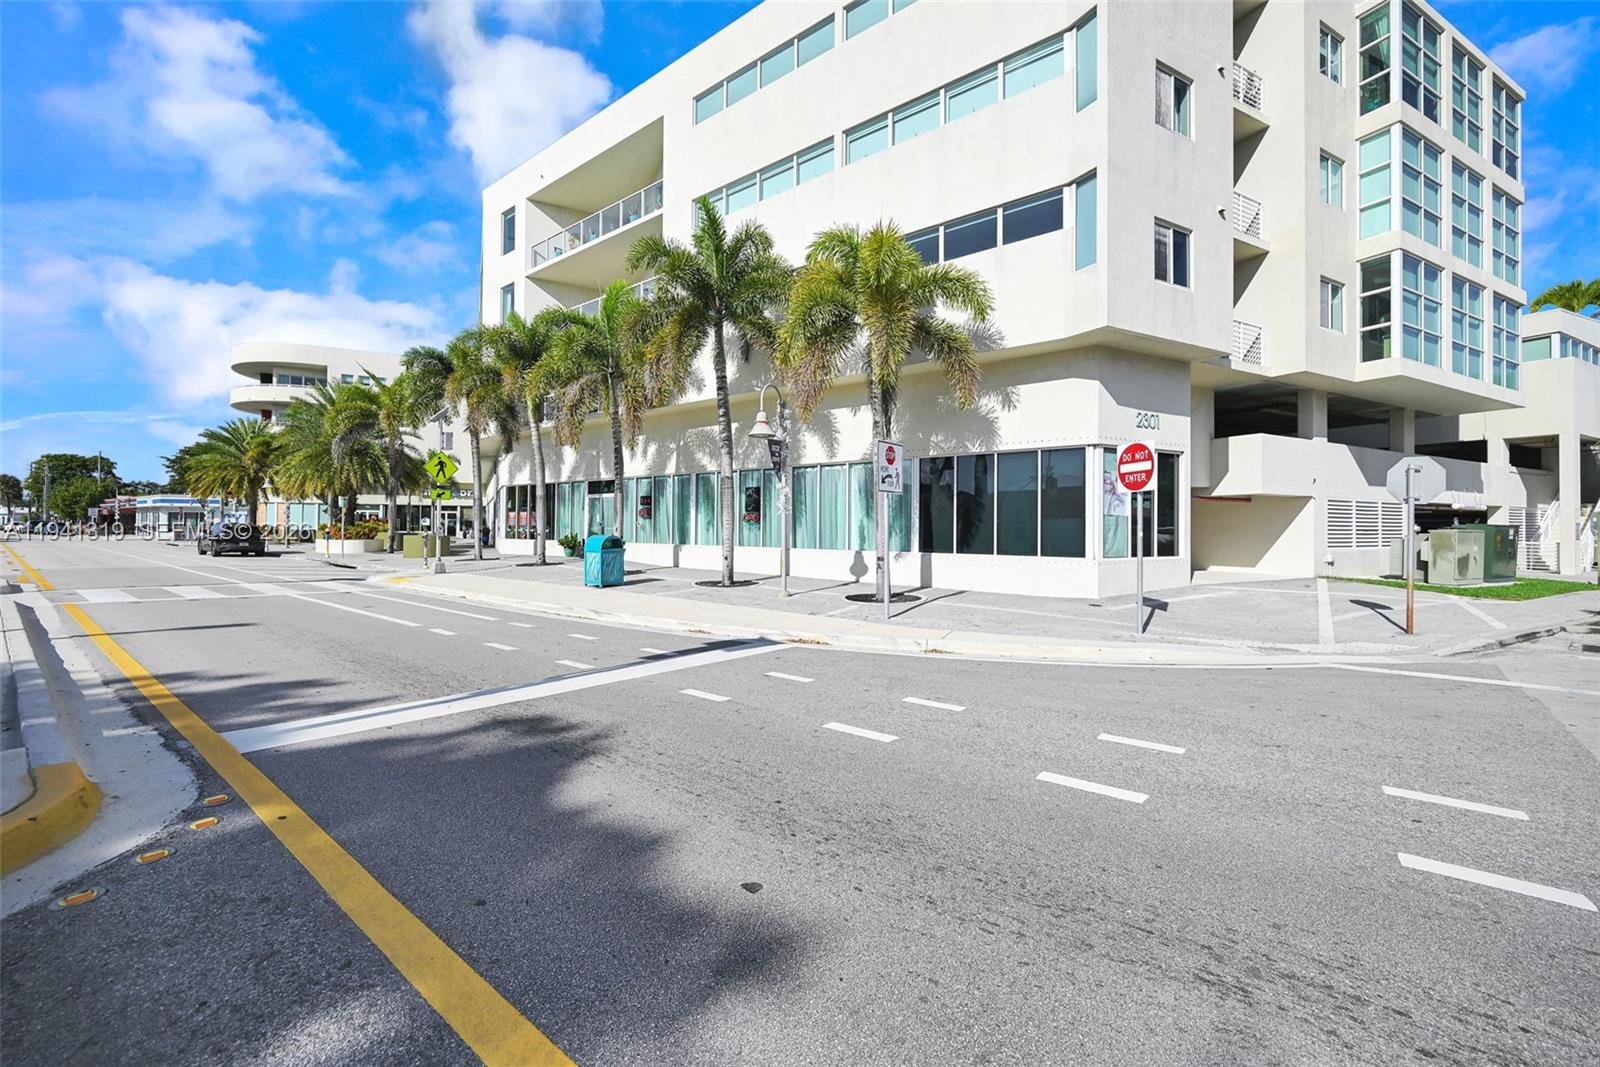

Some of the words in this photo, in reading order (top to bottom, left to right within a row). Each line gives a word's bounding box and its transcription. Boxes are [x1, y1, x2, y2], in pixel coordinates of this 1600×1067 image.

[1136, 412, 1160, 430] 2301
[1122, 453, 1132, 462] DO
[1135, 450, 1149, 460] NOT
[1125, 473, 1147, 484] ENTER
